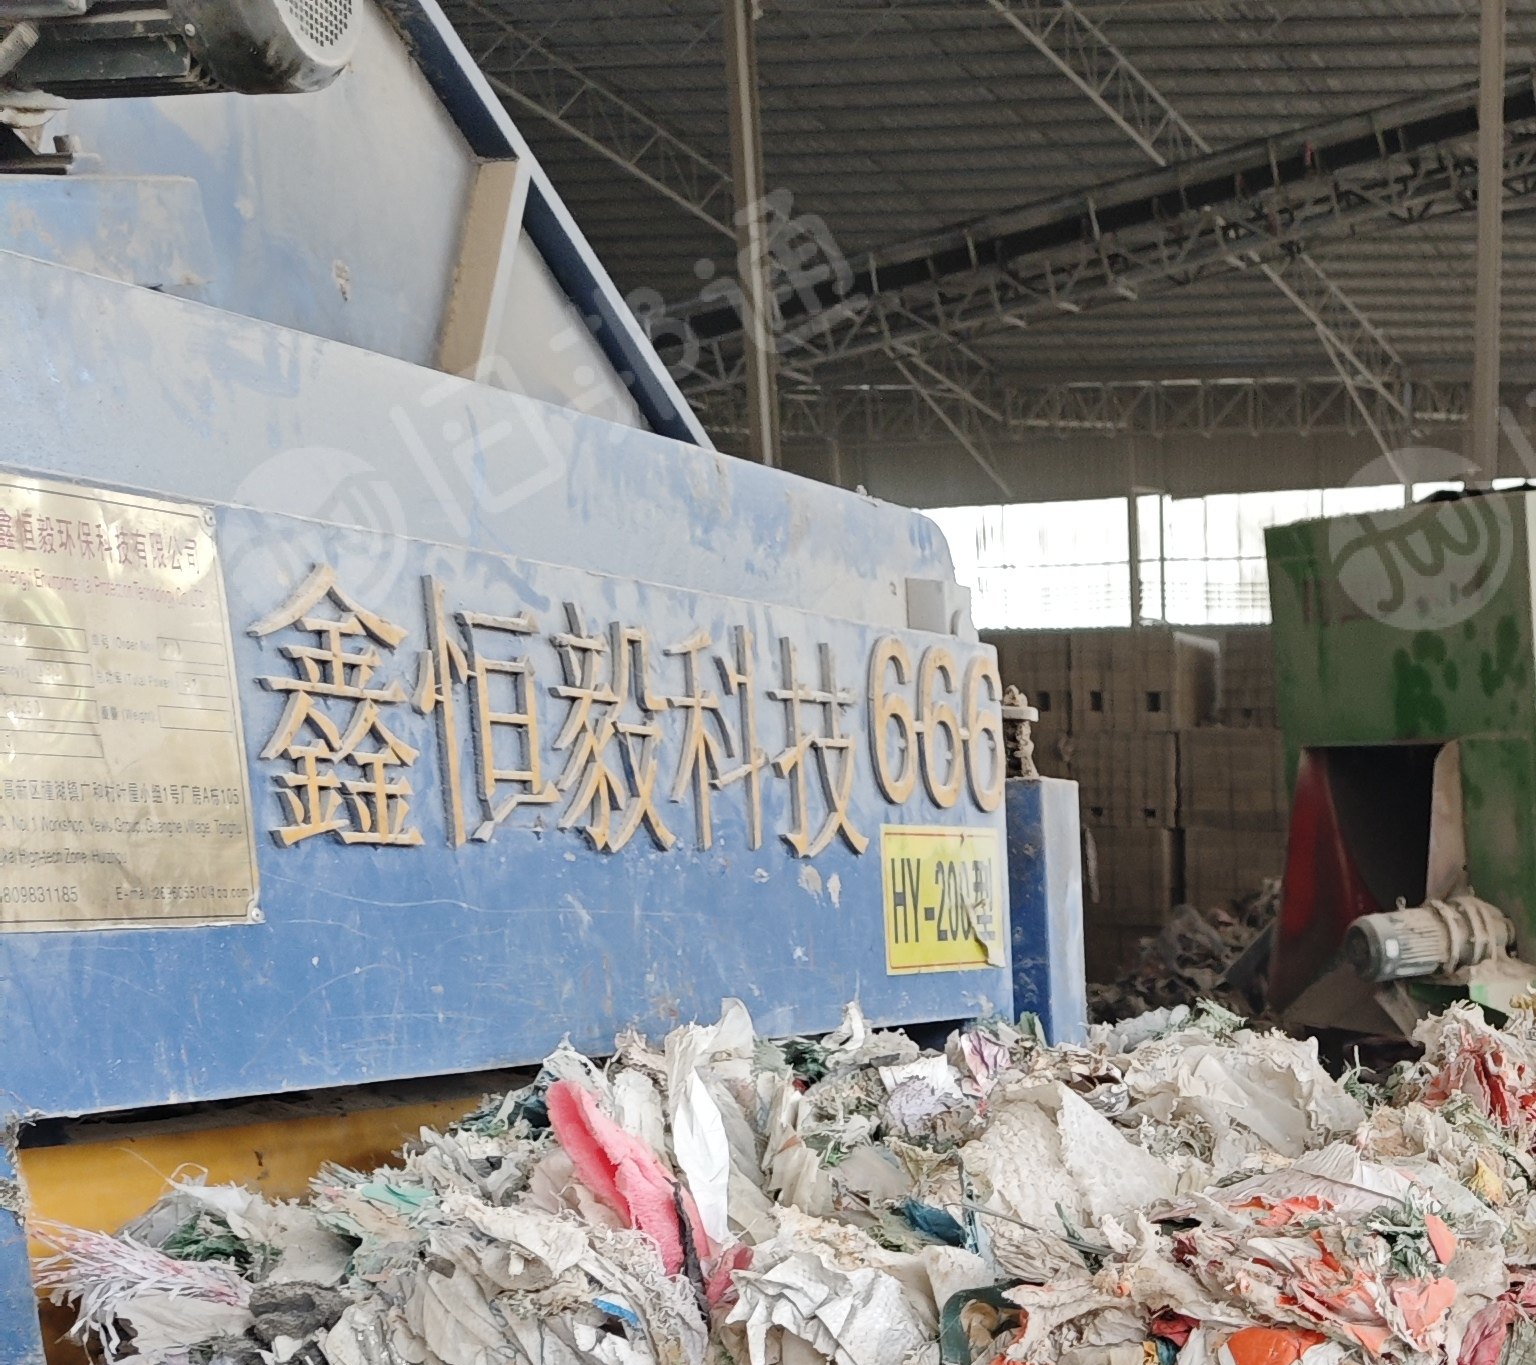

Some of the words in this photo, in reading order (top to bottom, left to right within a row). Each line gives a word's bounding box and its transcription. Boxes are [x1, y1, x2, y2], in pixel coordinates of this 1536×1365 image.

[247, 562, 1004, 858] 鑫恒毅科技666
